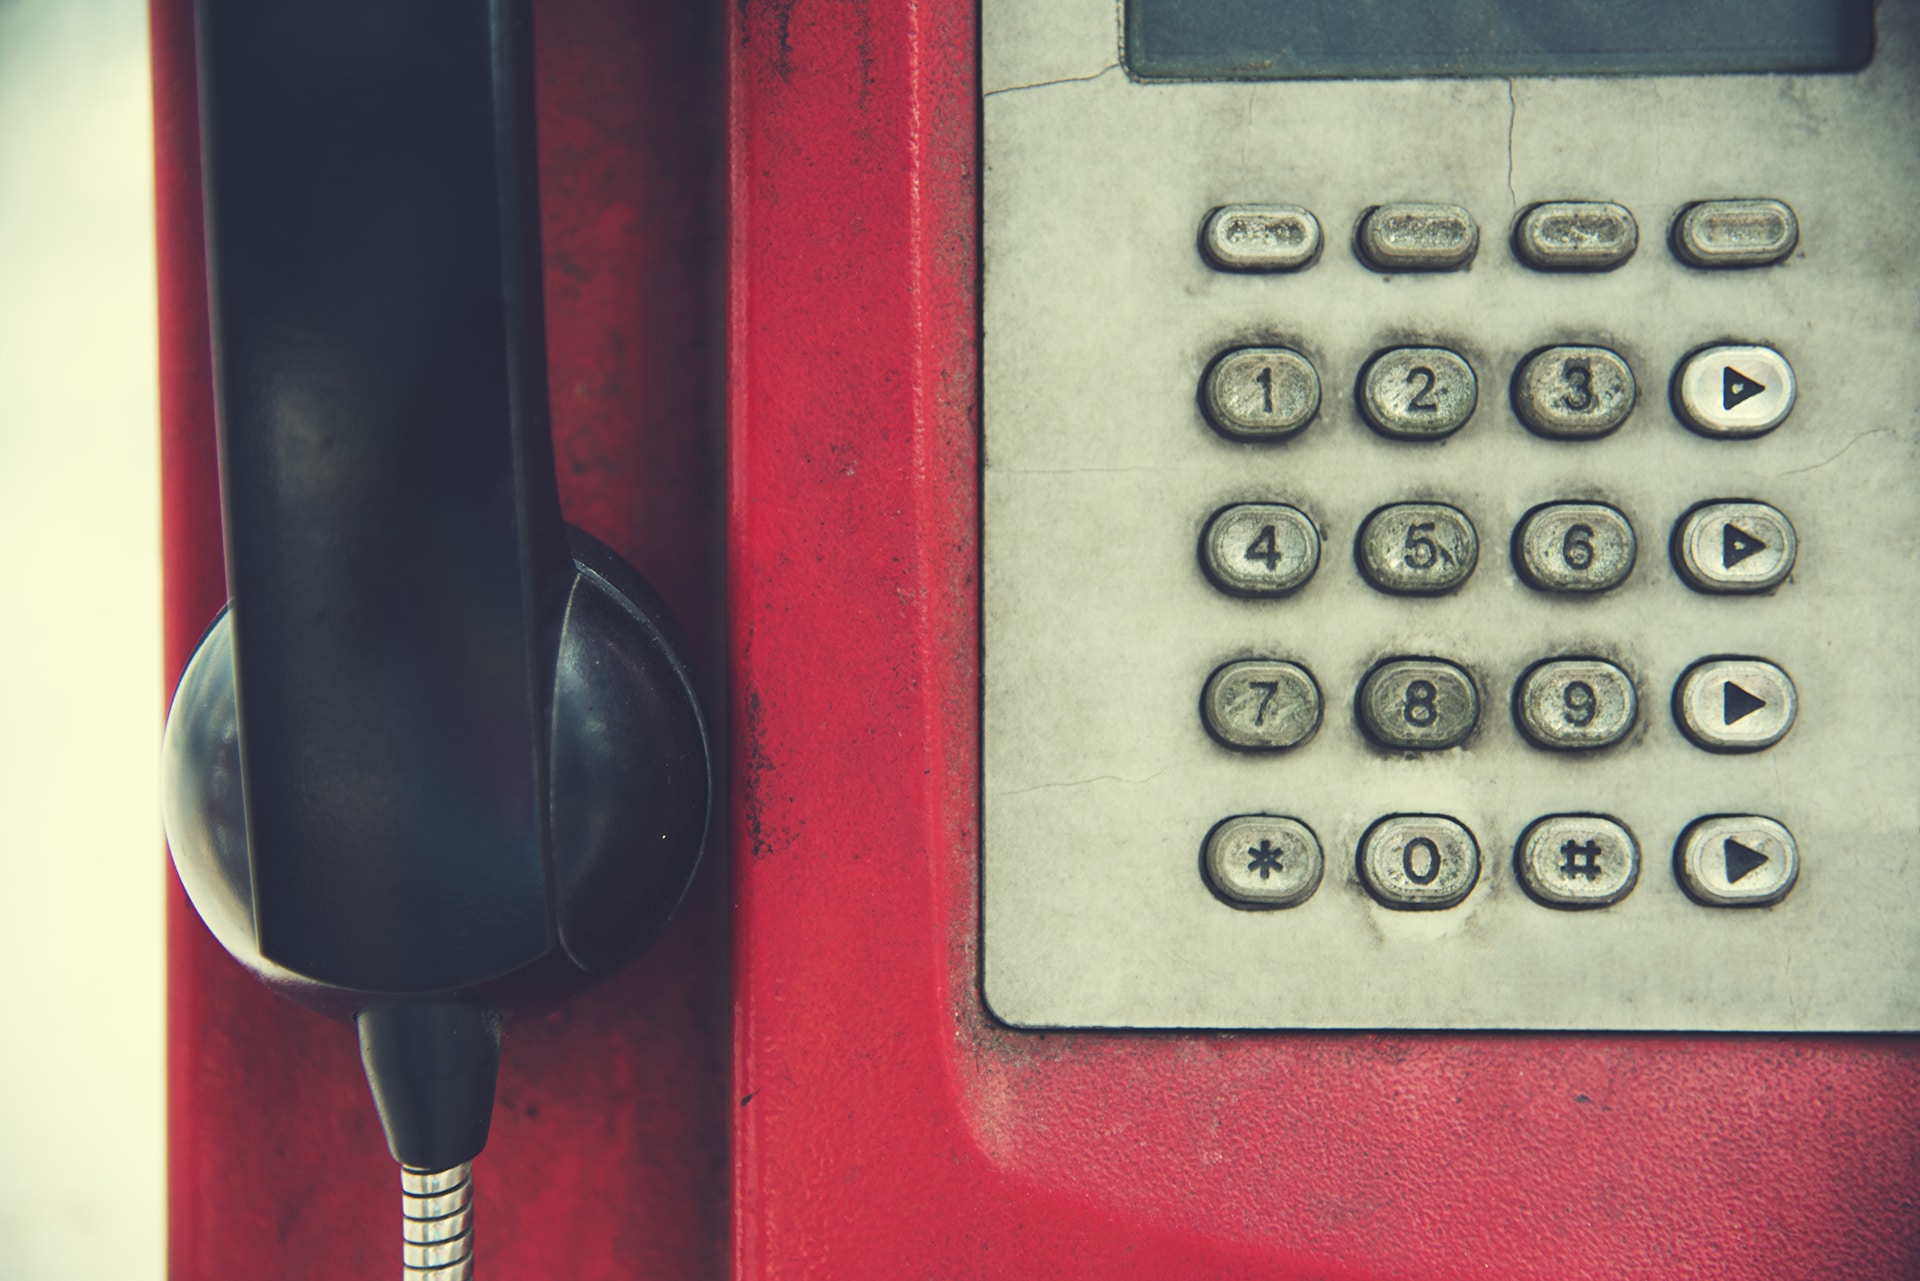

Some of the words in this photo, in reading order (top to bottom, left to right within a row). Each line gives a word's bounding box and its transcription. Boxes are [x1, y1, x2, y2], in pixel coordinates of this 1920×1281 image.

[1256, 367, 1274, 413] 1
[1407, 366, 1438, 413] 2
[1564, 366, 1592, 410] 3
[1244, 525, 1280, 569] 4
[1406, 523, 1436, 570] 5
[1563, 525, 1594, 570] 6
[1250, 681, 1278, 726] 7
[1404, 680, 1437, 728] 8
[1563, 681, 1595, 727] 9
[1403, 837, 1440, 885] 0
[1560, 840, 1601, 880] #
